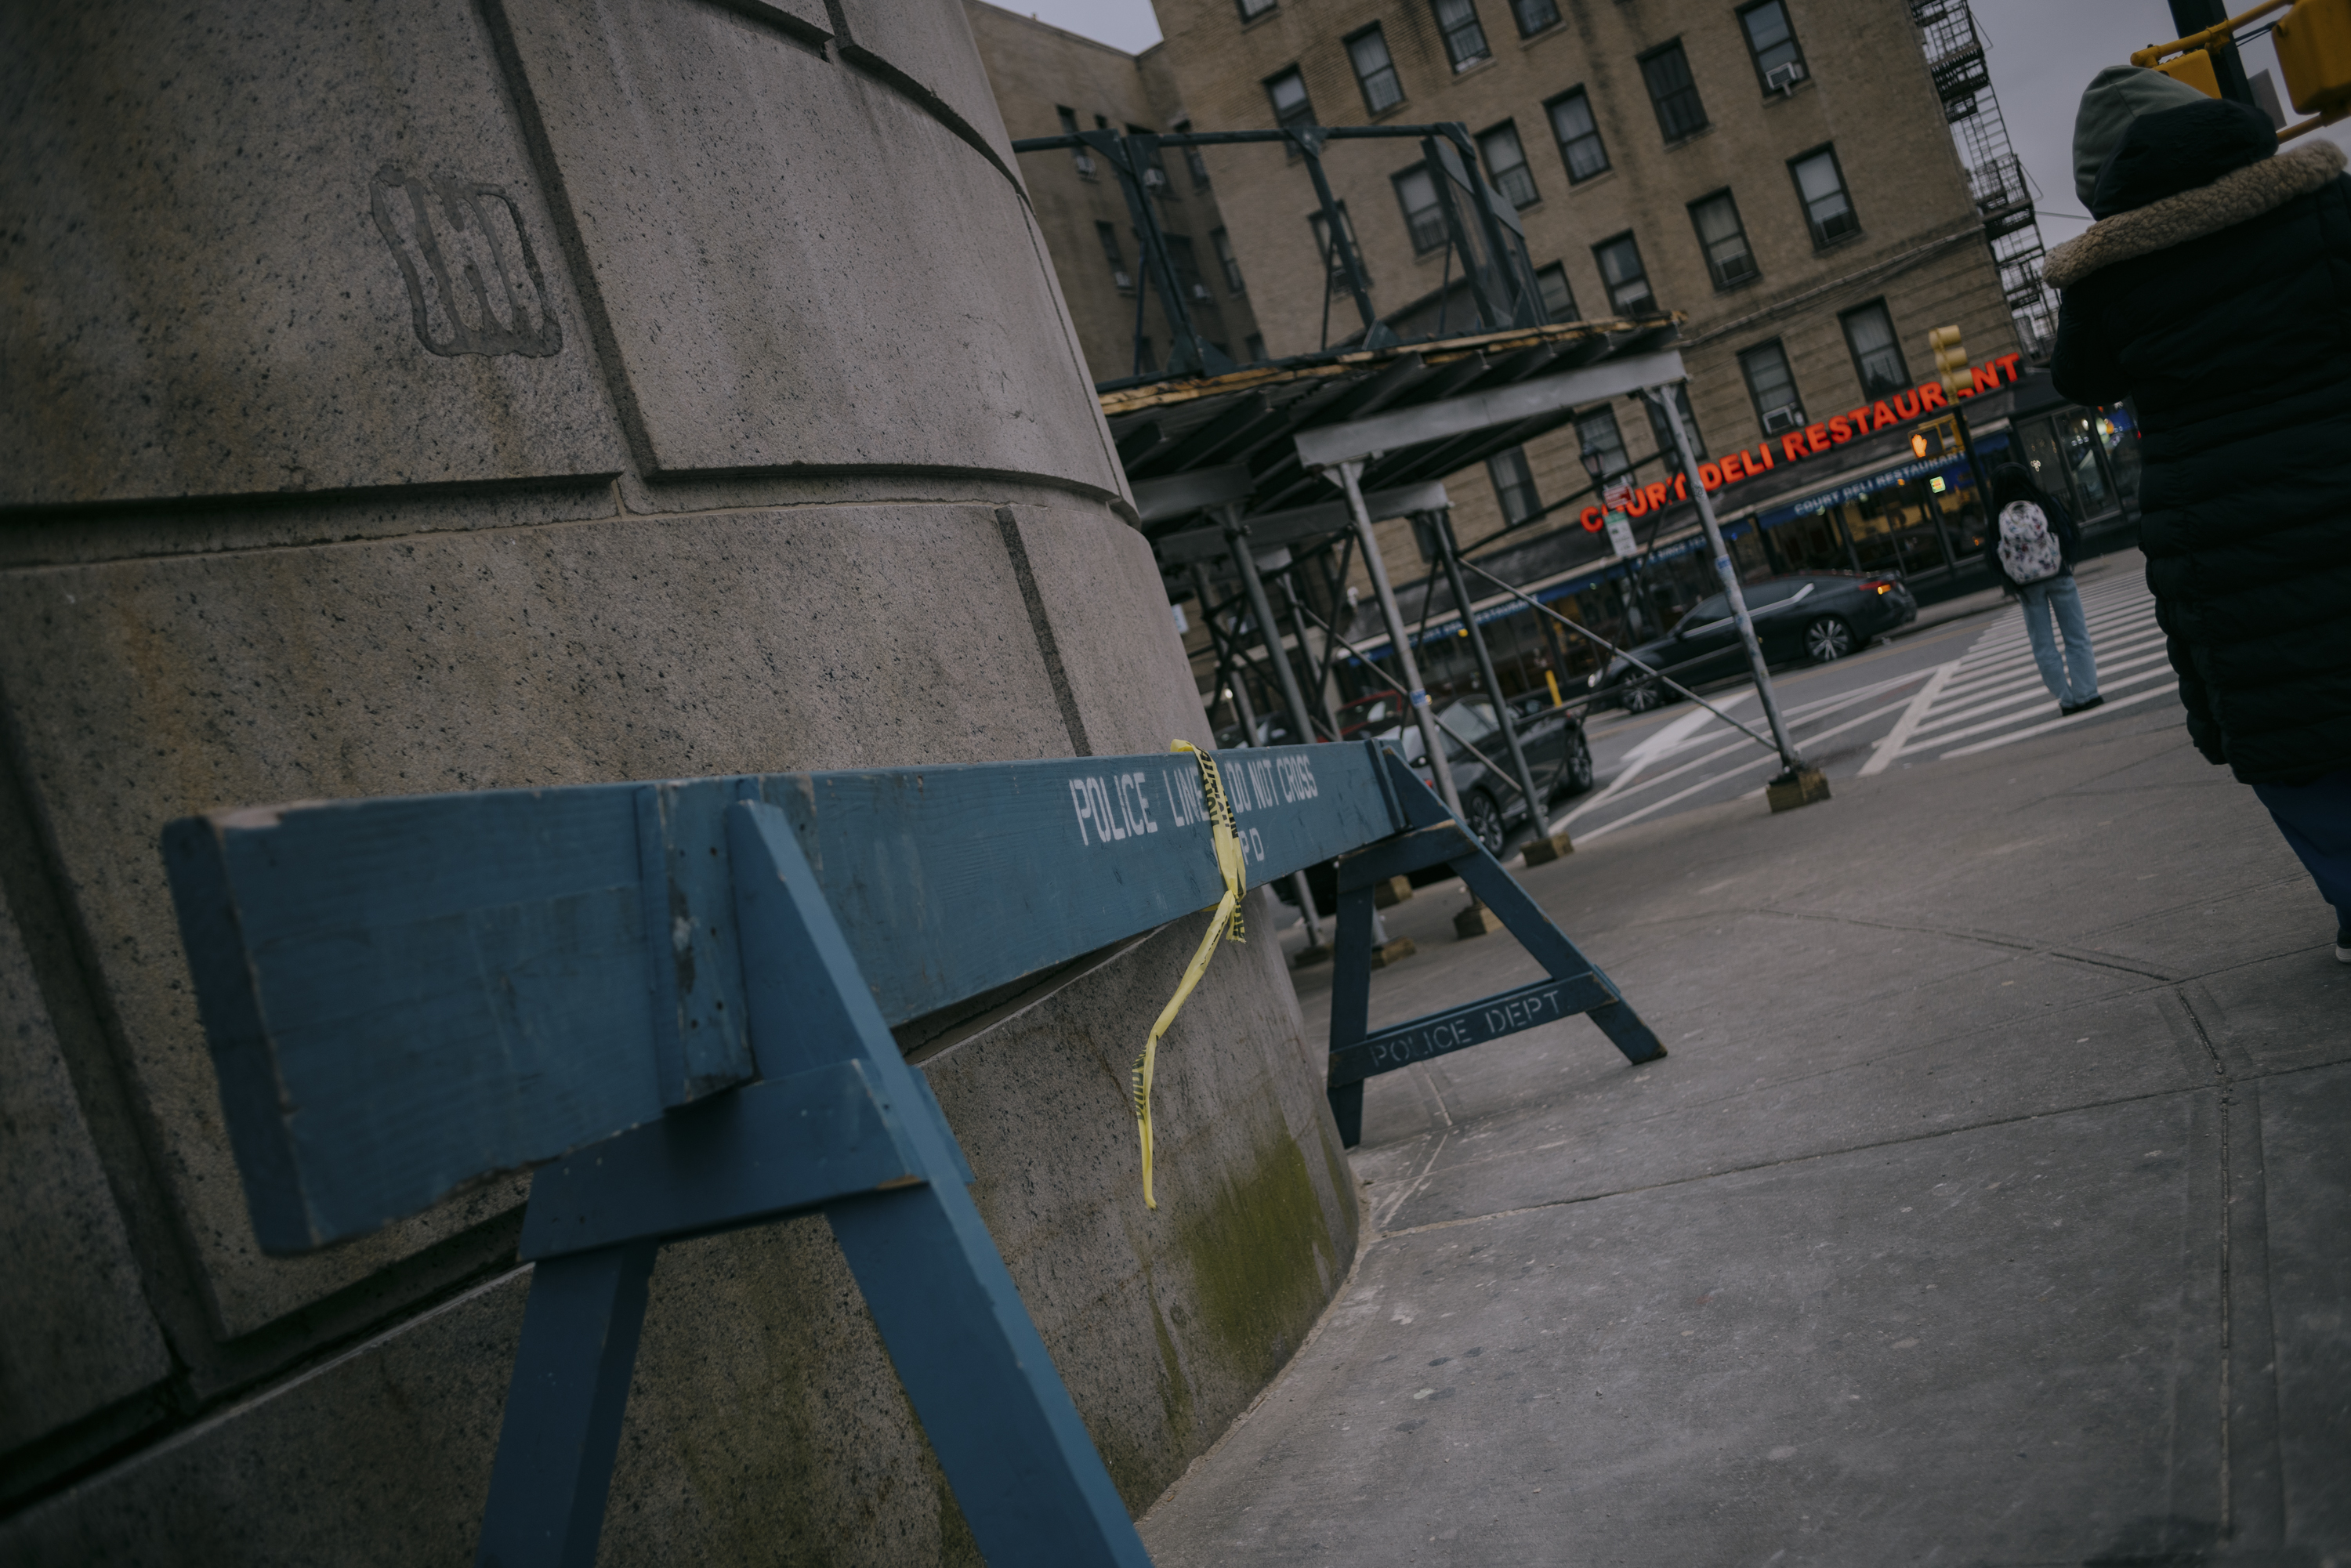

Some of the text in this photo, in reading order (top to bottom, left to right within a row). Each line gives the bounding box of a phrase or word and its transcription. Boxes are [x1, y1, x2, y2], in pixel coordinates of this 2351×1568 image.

[1580, 472, 1687, 533] CURT
[1697, 442, 1774, 492] DELI
[1780, 352, 2020, 462] RESTAURNT
[1794, 491, 1840, 516] COURT
[1842, 480, 1874, 498] DELI
[1875, 450, 1965, 488] RESTAURANT
[1069, 771, 1157, 846] POLICE
[1163, 765, 1210, 827] LINE
[1225, 761, 1252, 813] DO
[1248, 759, 1279, 809] NOT
[1277, 754, 1318, 803] CROSS
[1370, 990, 1561, 1067] POLICE DEPT
